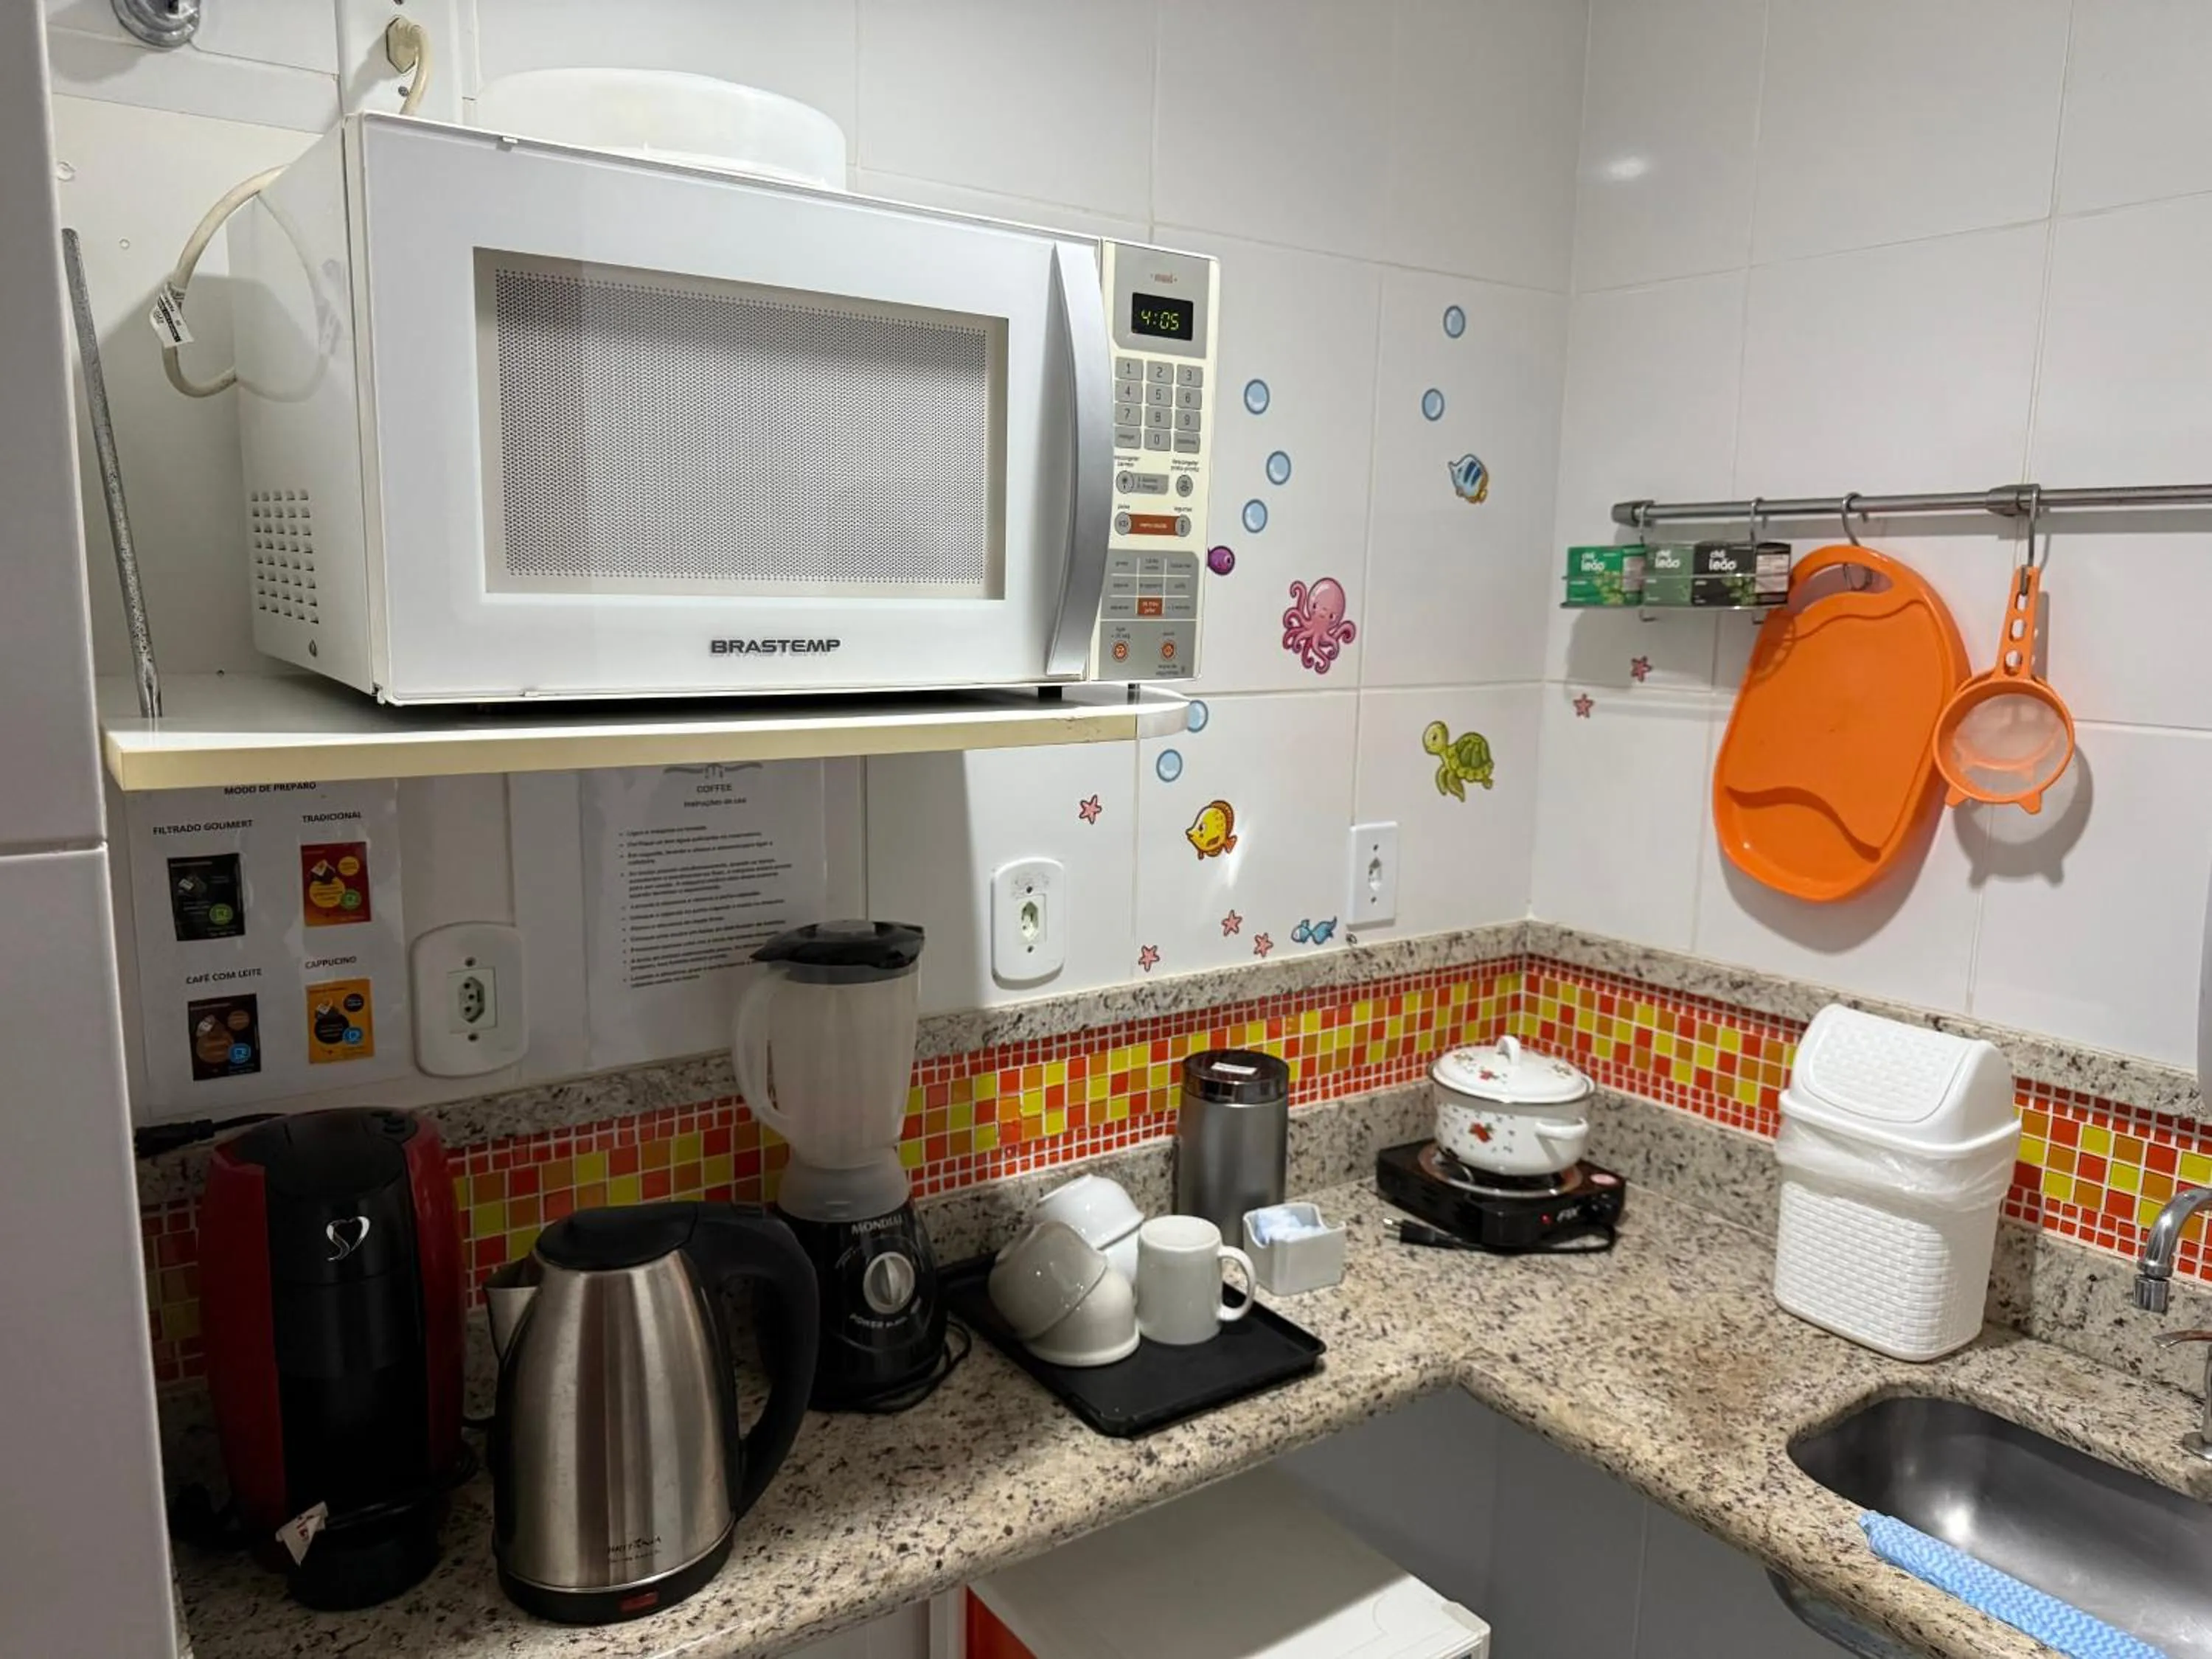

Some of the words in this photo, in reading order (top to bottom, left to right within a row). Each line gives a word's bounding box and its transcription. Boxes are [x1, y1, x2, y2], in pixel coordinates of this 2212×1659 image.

[1141, 310, 1179, 330] 4:05
[1156, 366, 1163, 378] 2
[1186, 370, 1192, 380] 3
[1125, 386, 1131, 397] 4
[1155, 389, 1161, 400] 5
[1185, 392, 1191, 403] 6
[1124, 408, 1130, 420] 7
[1155, 412, 1161, 422] 8
[1184, 414, 1190, 425] 9
[1154, 435, 1160, 445] 0
[1708, 557, 1736, 571] leão
[710, 639, 841, 654] BRASTEMP
[224, 785, 257, 796] MODO
[258, 784, 271, 793] DE
[274, 781, 317, 793] PREPARO
[696, 782, 733, 794] COFFEE
[302, 811, 362, 824] TRADICIONAL
[153, 824, 201, 835] FILTRADO
[204, 818, 253, 832] GOUMERT
[305, 956, 357, 970] CAPPUCINO
[212, 970, 237, 981] COM
[238, 967, 262, 979] LEITE
